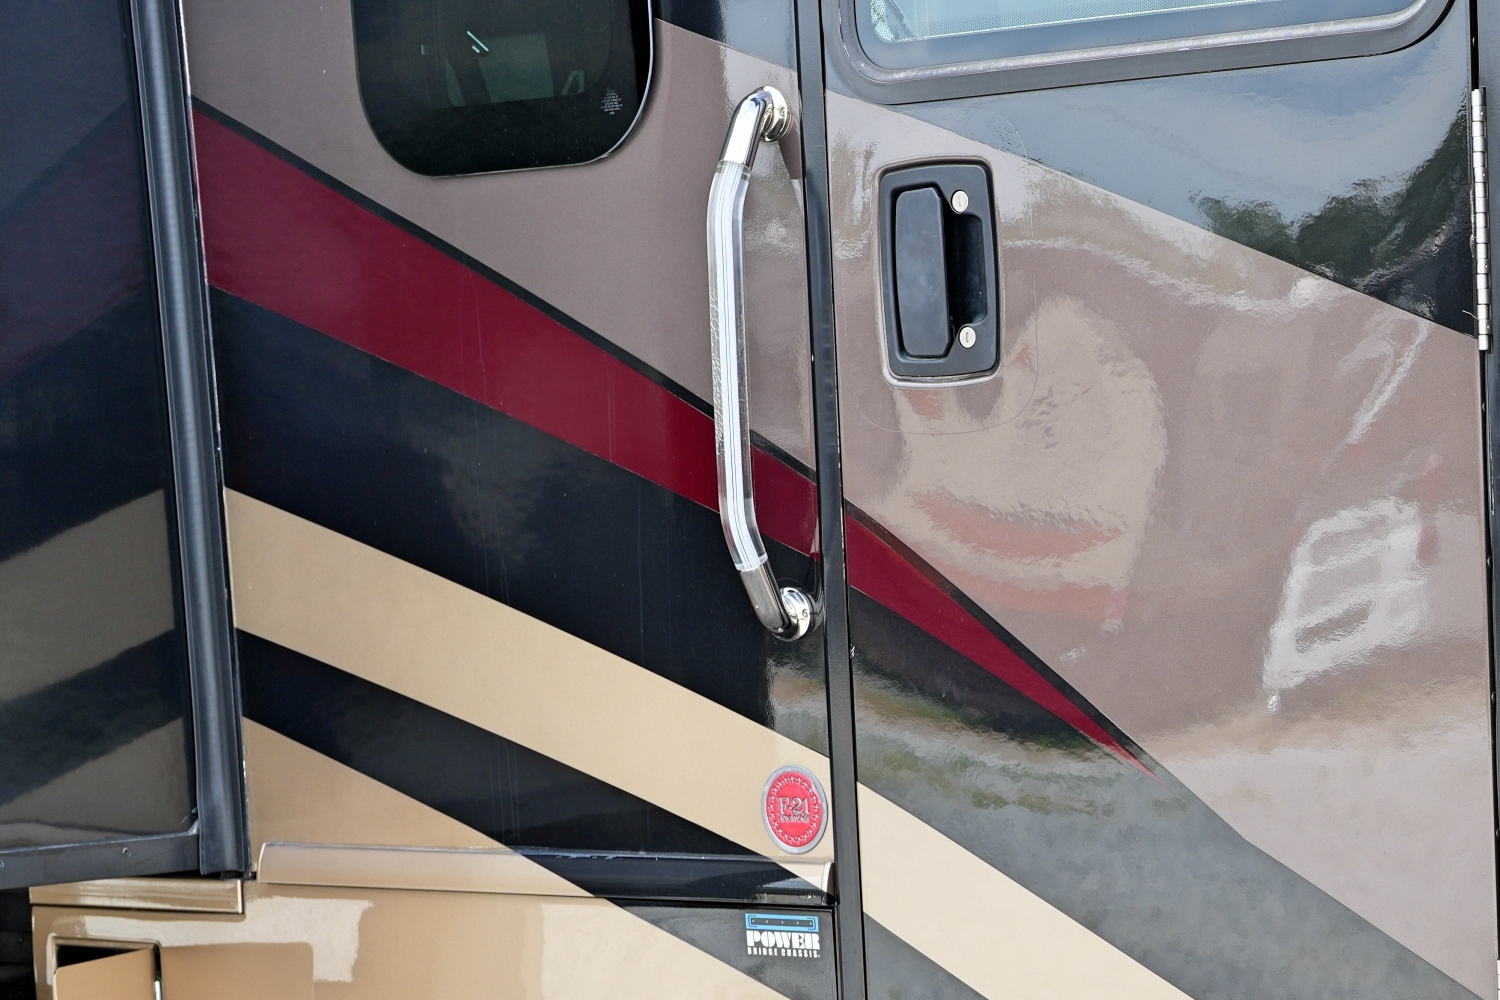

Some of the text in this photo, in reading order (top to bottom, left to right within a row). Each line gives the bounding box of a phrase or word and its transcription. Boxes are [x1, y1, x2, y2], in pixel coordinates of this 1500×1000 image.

[778, 797, 810, 815] F-21
[746, 930, 820, 950] POWER
[747, 947, 818, 958] BRIDGE CHASSIS
